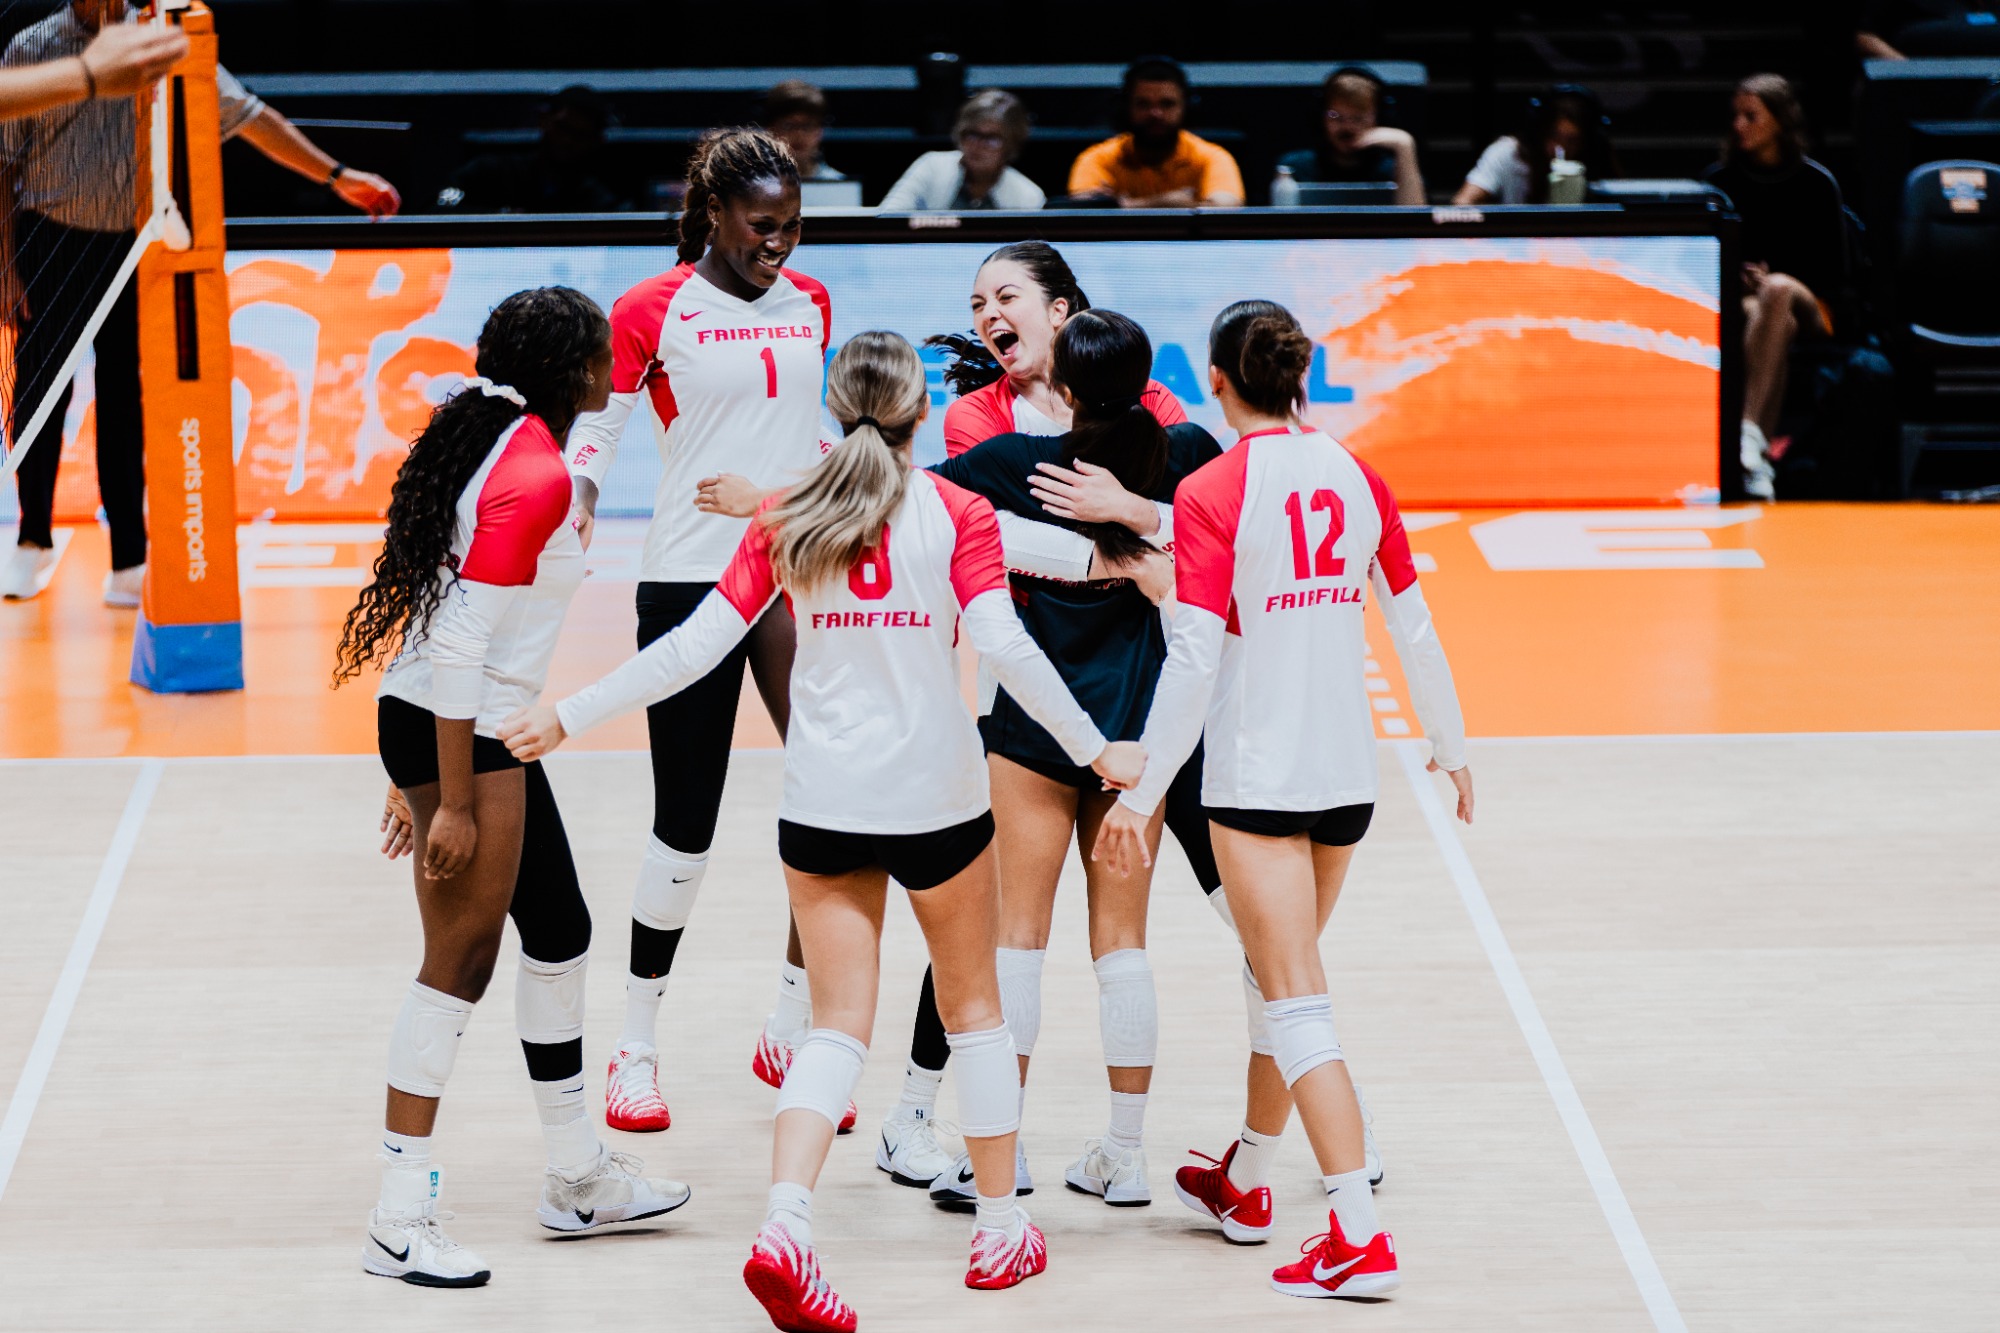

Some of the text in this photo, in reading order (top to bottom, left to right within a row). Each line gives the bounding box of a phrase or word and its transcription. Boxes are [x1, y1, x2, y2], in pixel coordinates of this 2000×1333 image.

[696, 325, 813, 344] FAIRFIELD
[760, 347, 777, 399] 1
[178, 417, 209, 583] sports imports
[1284, 488, 1346, 581] 12
